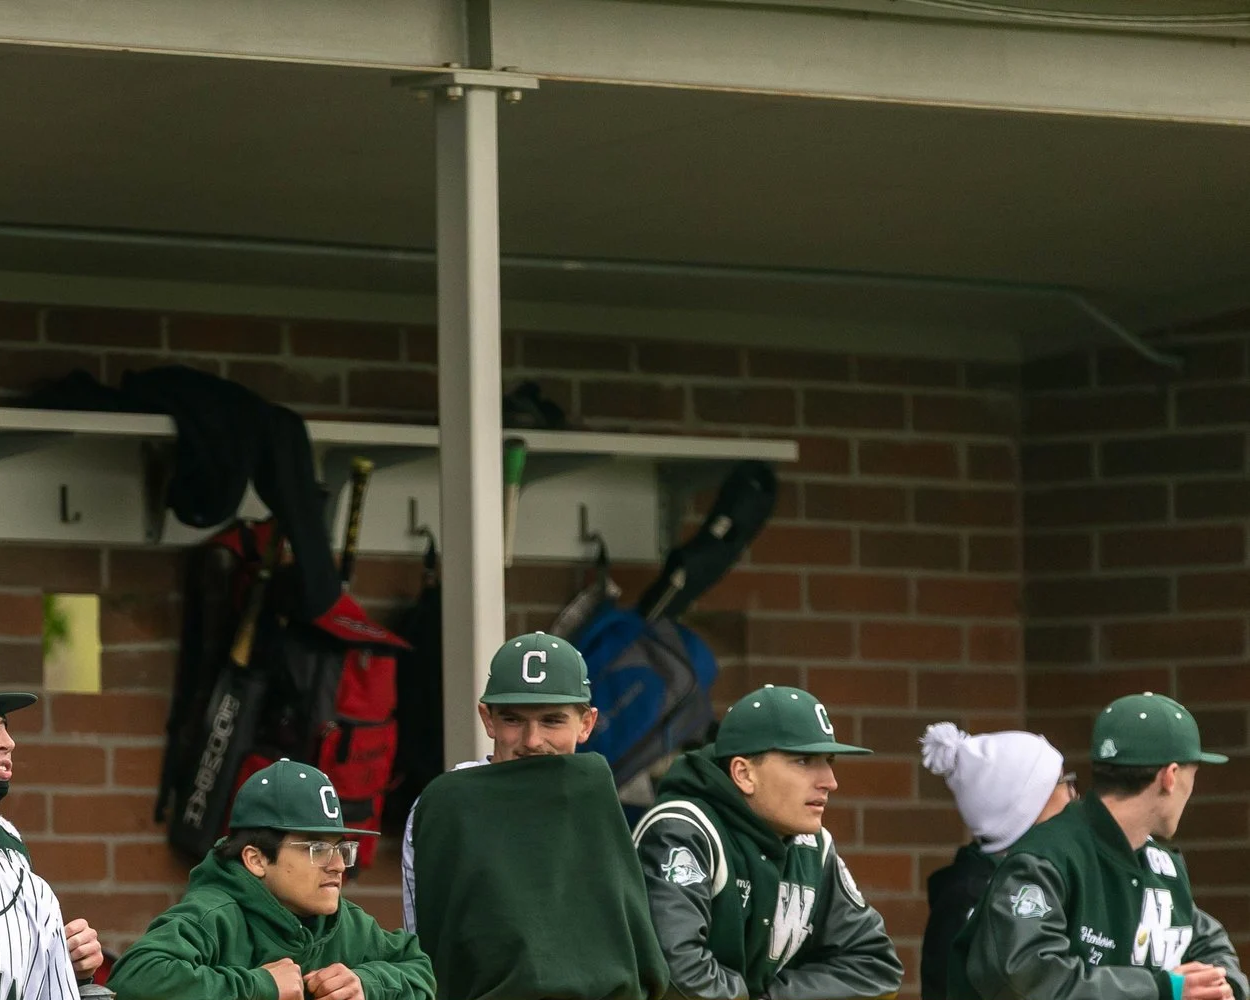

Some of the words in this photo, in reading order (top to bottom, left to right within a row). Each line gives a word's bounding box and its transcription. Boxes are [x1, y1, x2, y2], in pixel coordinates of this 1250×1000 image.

[523, 651, 547, 683] C
[815, 704, 834, 735] C
[183, 694, 240, 830] BOOMBAH
[319, 786, 339, 819] C
